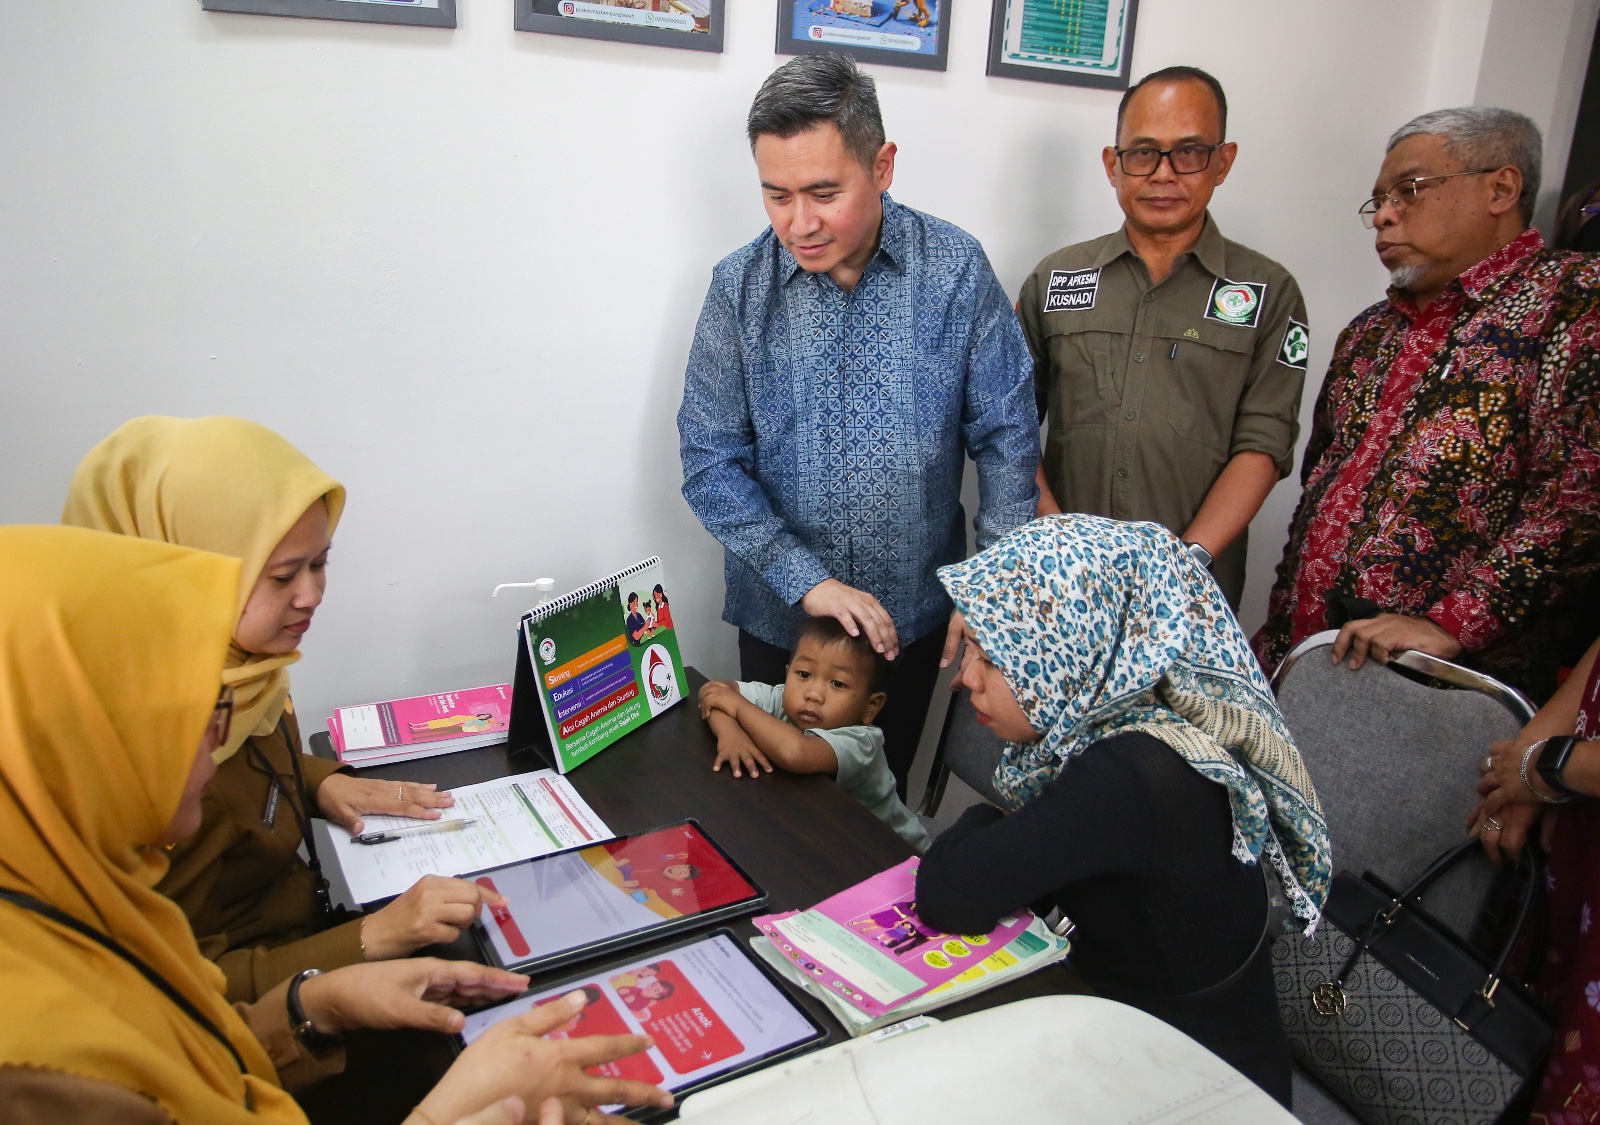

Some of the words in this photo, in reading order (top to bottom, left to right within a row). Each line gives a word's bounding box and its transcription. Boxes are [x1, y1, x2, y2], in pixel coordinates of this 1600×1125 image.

[1052, 276, 1067, 287] DPP
[1067, 273, 1096, 287] APKESMI
[1050, 292, 1092, 306] KUSNADI
[590, 705, 608, 721] Anemia
[616, 690, 634, 706] Stunting
[690, 1007, 713, 1028] Anak
